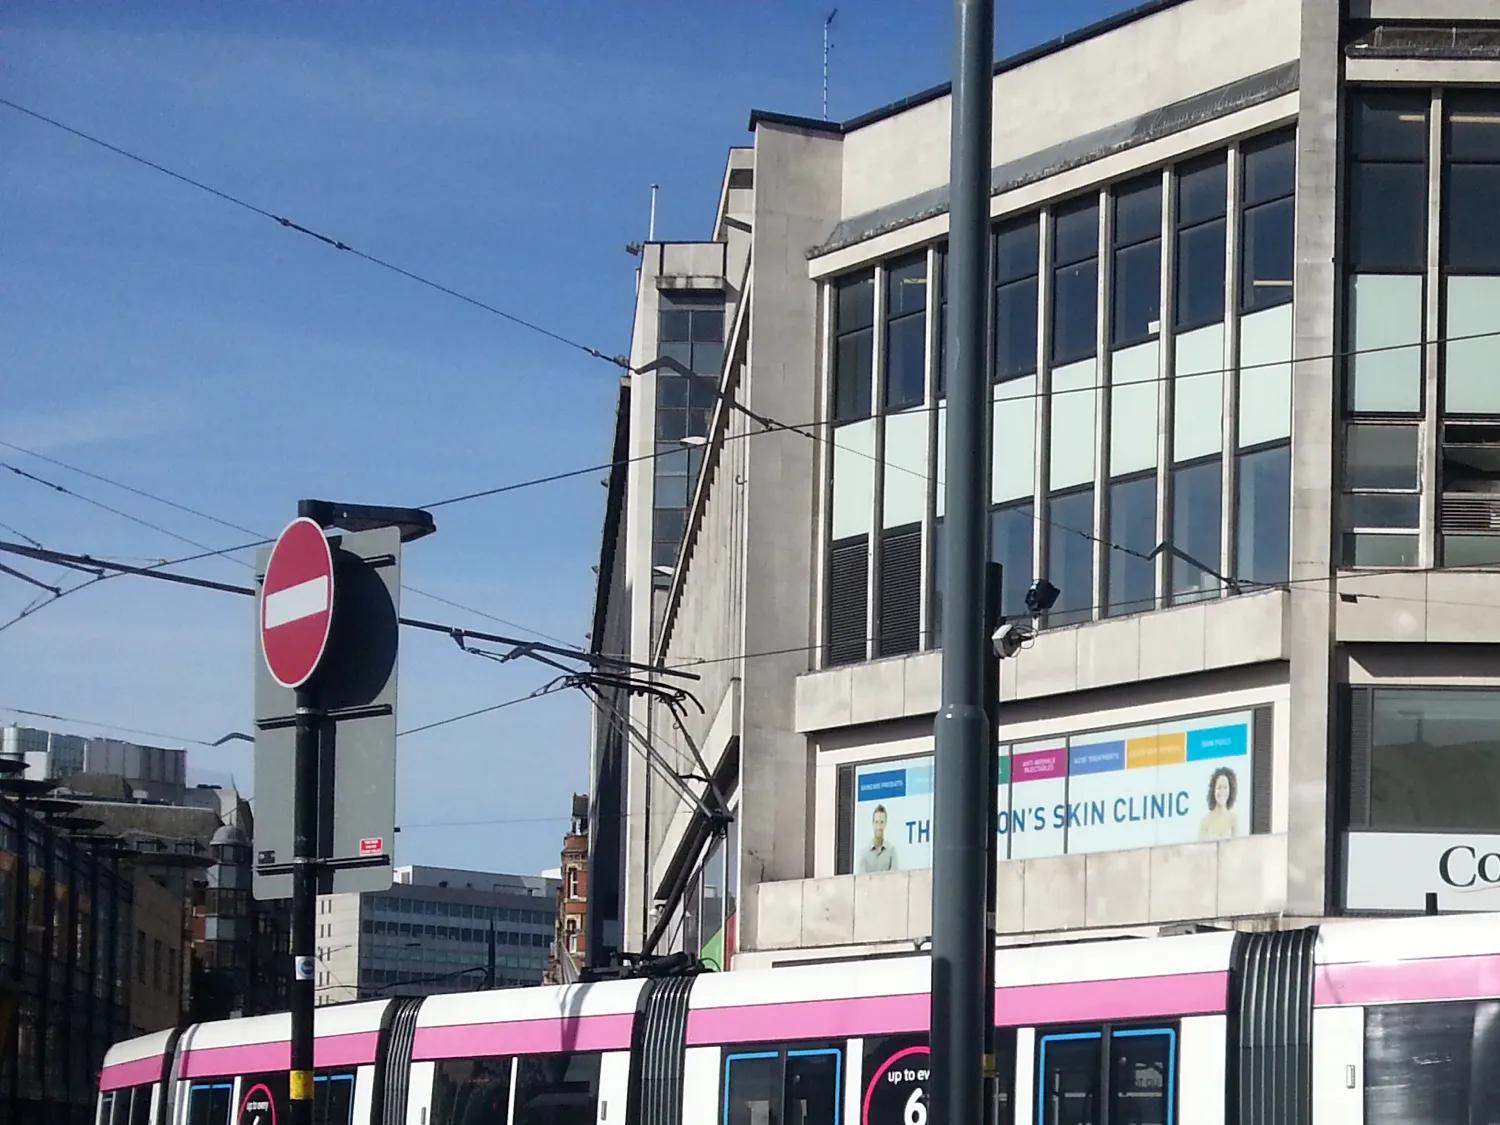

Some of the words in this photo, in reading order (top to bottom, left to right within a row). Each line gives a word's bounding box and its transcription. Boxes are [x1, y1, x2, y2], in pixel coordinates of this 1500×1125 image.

[905, 819, 930, 844] TH
[997, 806, 1046, 834] ON'S
[1053, 800, 1105, 828] SKIN
[1113, 790, 1189, 823] CLINIC
[888, 1071, 902, 1085] up
[904, 1069, 915, 1081] to
